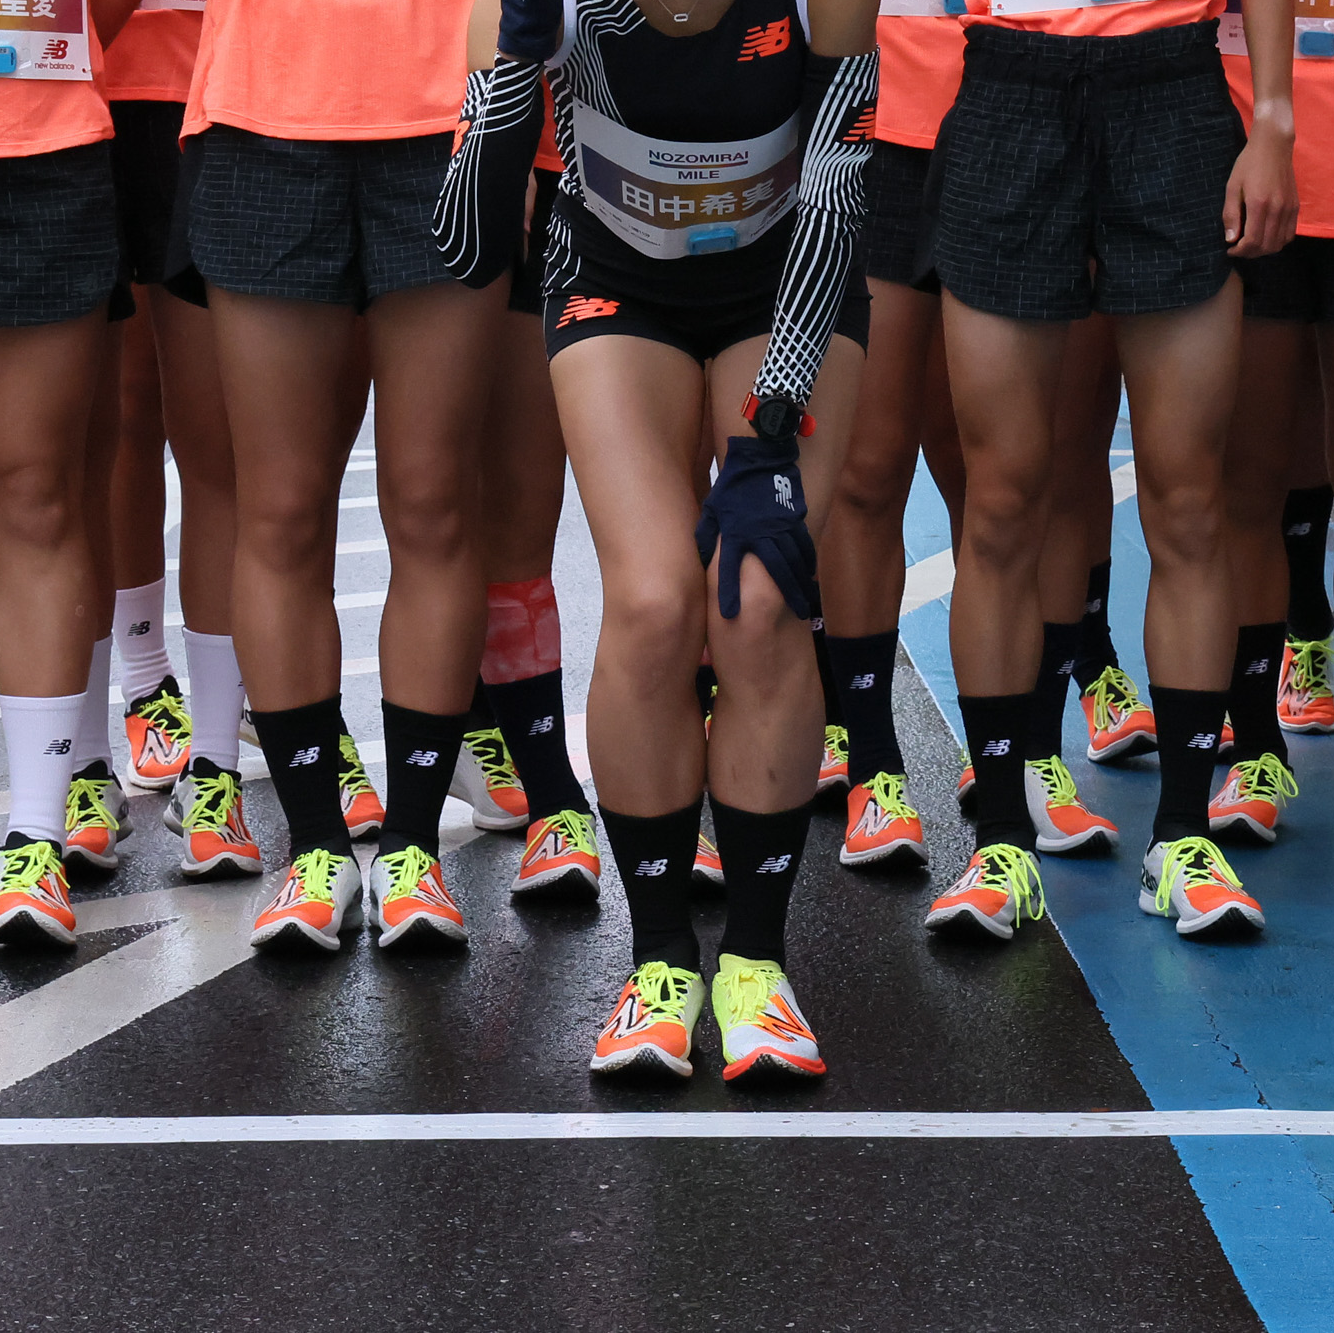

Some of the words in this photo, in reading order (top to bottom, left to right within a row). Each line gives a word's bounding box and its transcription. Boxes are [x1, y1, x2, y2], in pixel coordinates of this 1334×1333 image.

[34, 62, 48, 70] new
[49, 62, 75, 70] balance
[649, 150, 749, 164] NOZOMIRAI
[678, 170, 720, 180] MILE
[622, 177, 775, 221] 田中希実
